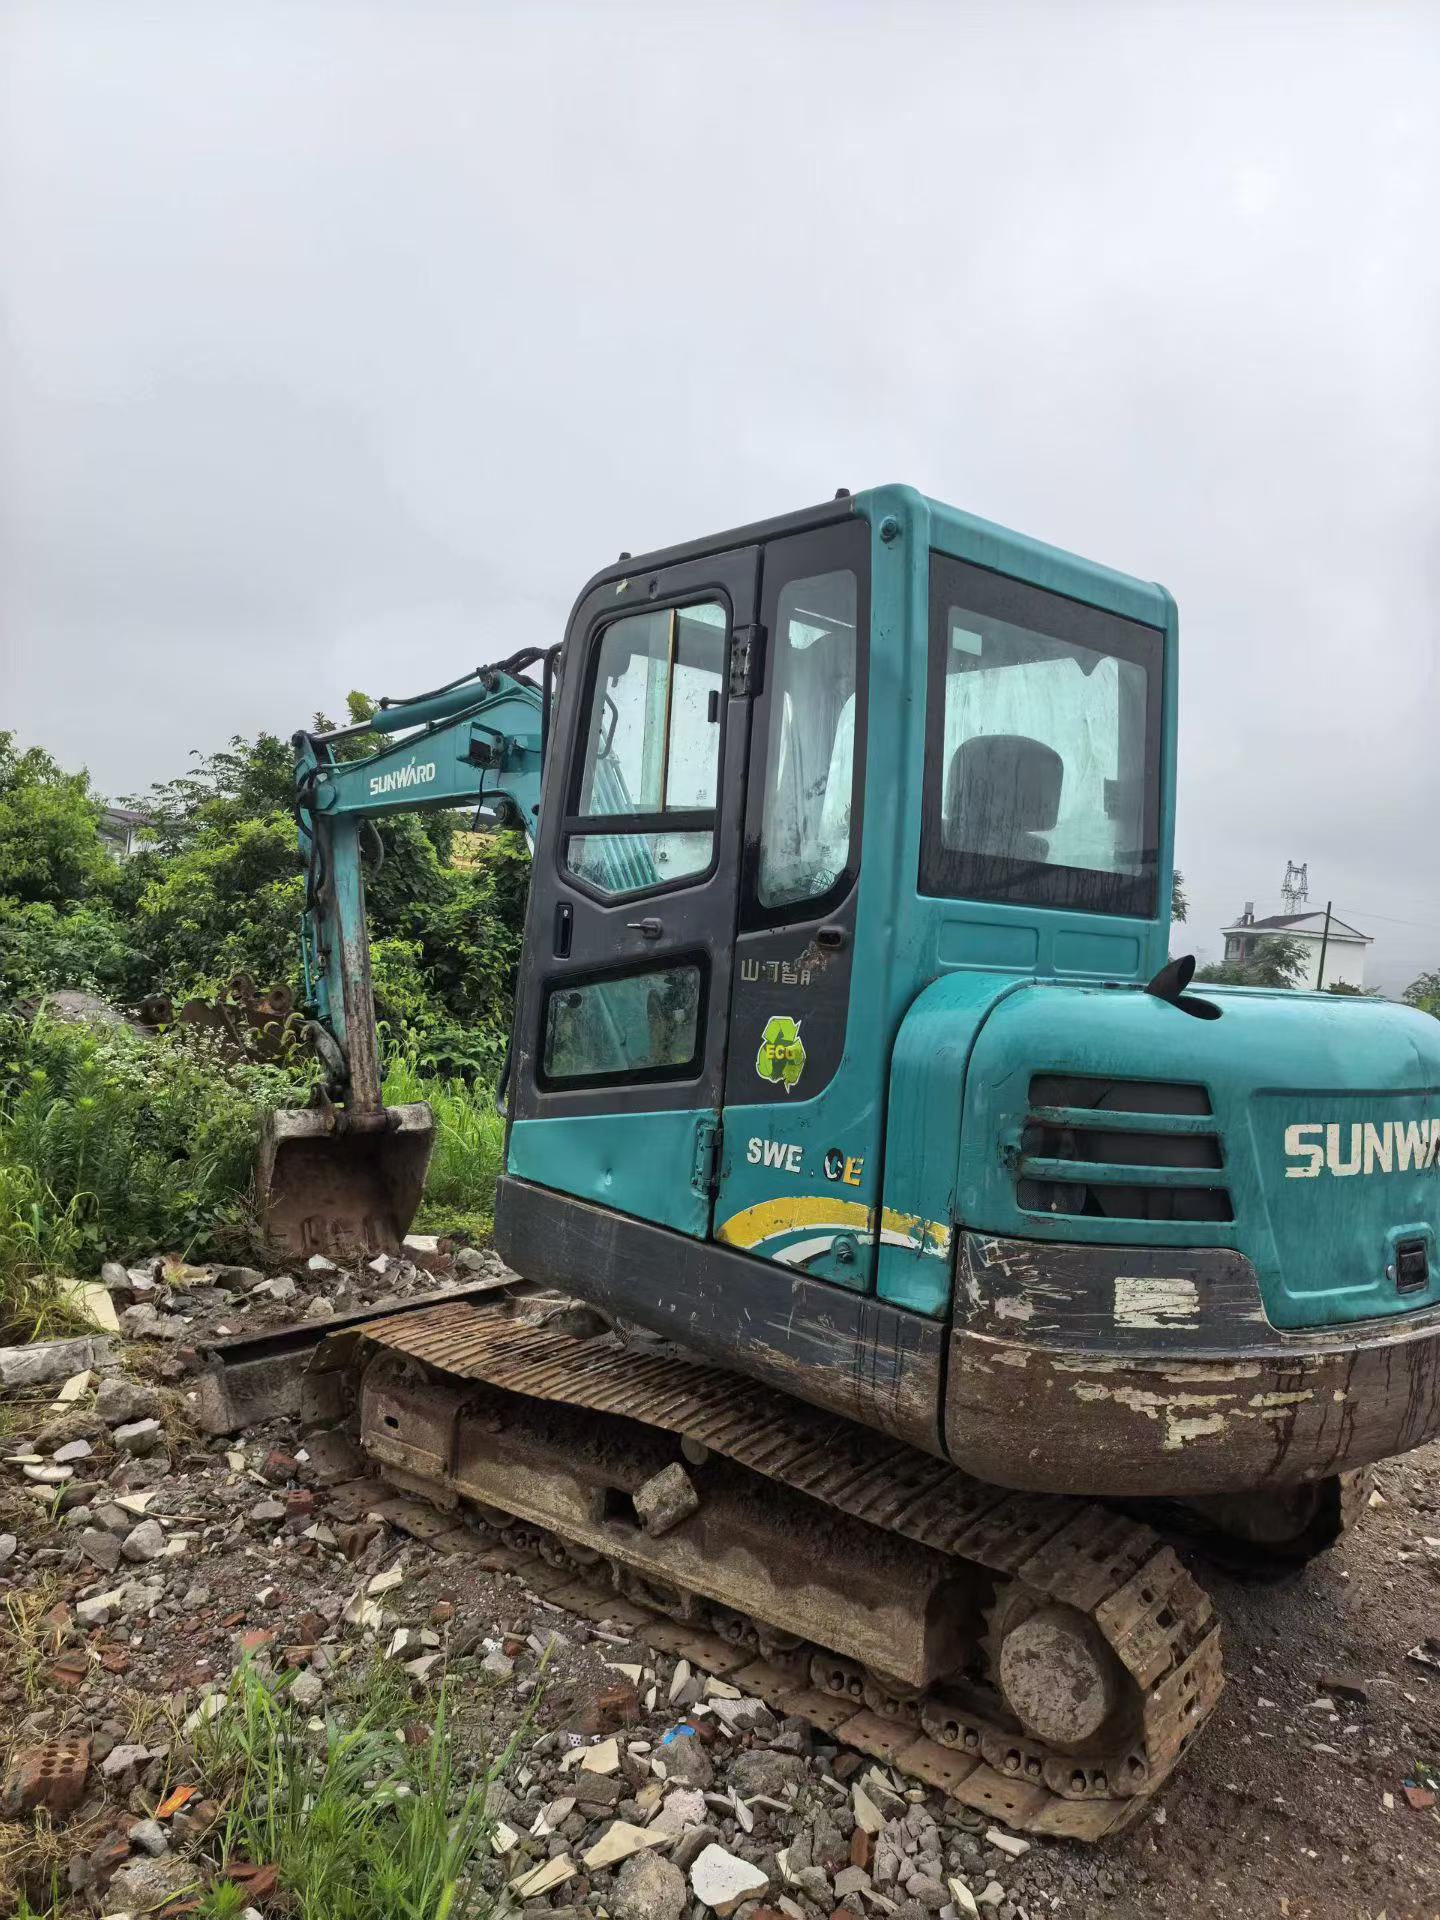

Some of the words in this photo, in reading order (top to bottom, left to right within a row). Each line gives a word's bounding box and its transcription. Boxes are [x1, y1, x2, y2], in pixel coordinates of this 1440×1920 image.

[369, 757, 436, 796] SUNWARD
[741, 958, 812, 986] 山河智
